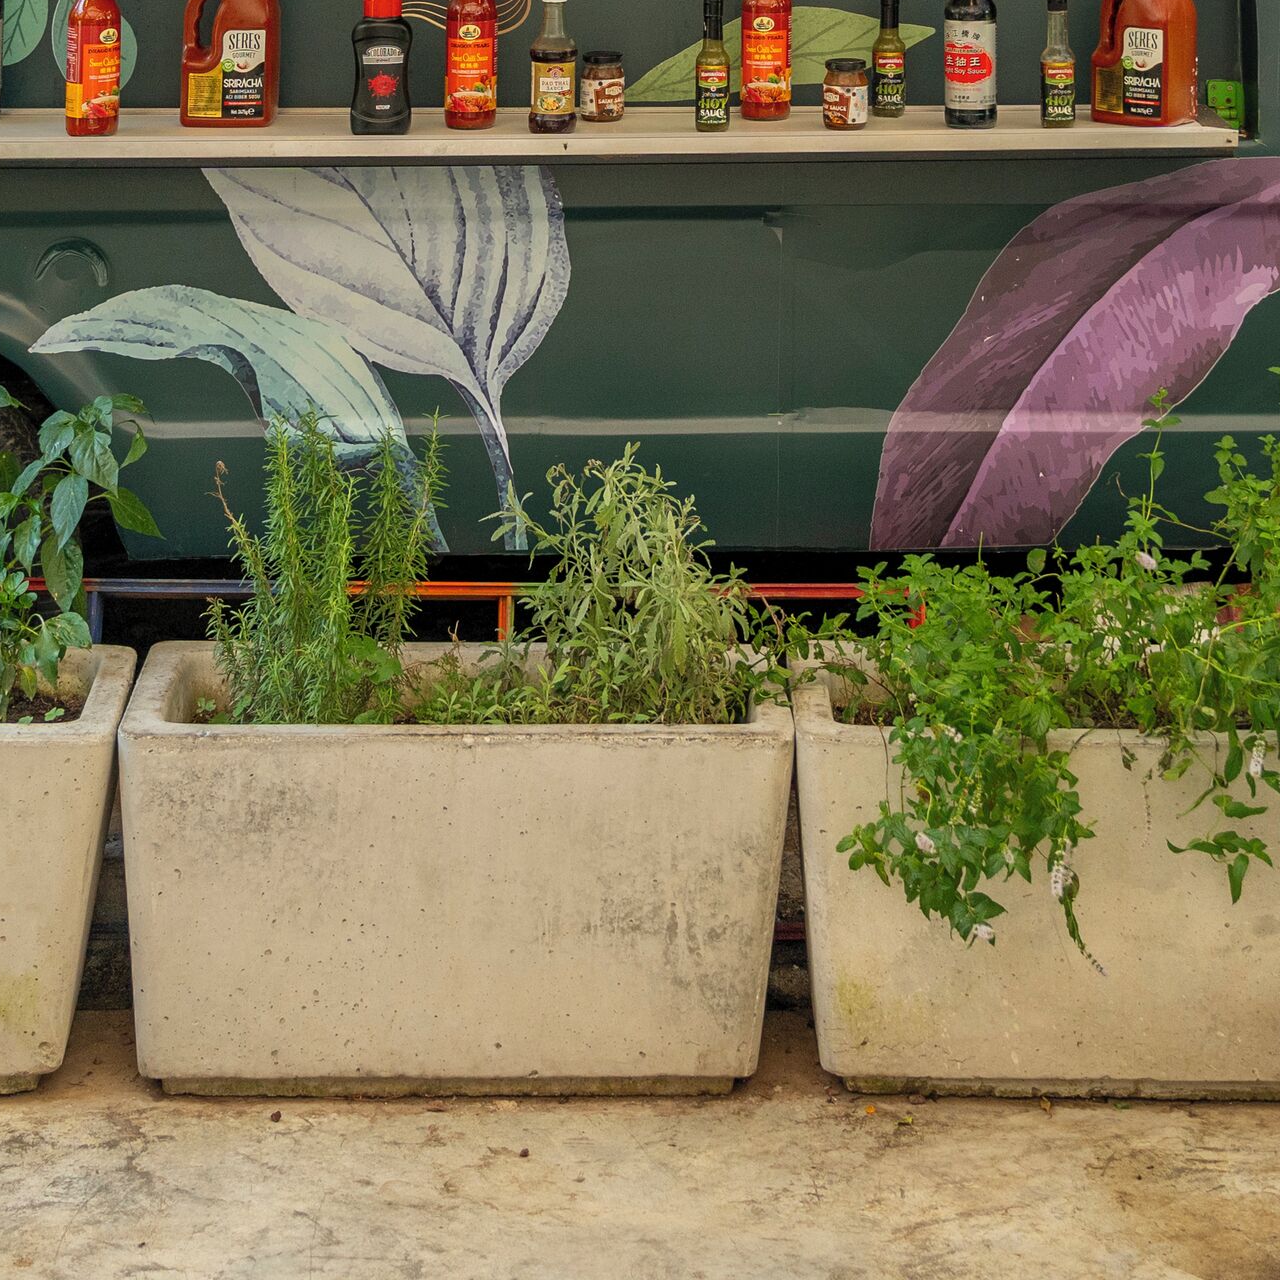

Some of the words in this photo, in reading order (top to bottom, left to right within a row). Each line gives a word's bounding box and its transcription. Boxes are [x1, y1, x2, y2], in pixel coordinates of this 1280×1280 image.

[229, 32, 260, 50] SERES
[1128, 31, 1158, 50] SERES
[367, 47, 401, 56] COLORADO
[945, 55, 981, 67] 生抽王
[954, 67, 966, 75] Soy
[223, 77, 263, 88] SRIRACHA
[1124, 76, 1161, 88] SRIRACHA
